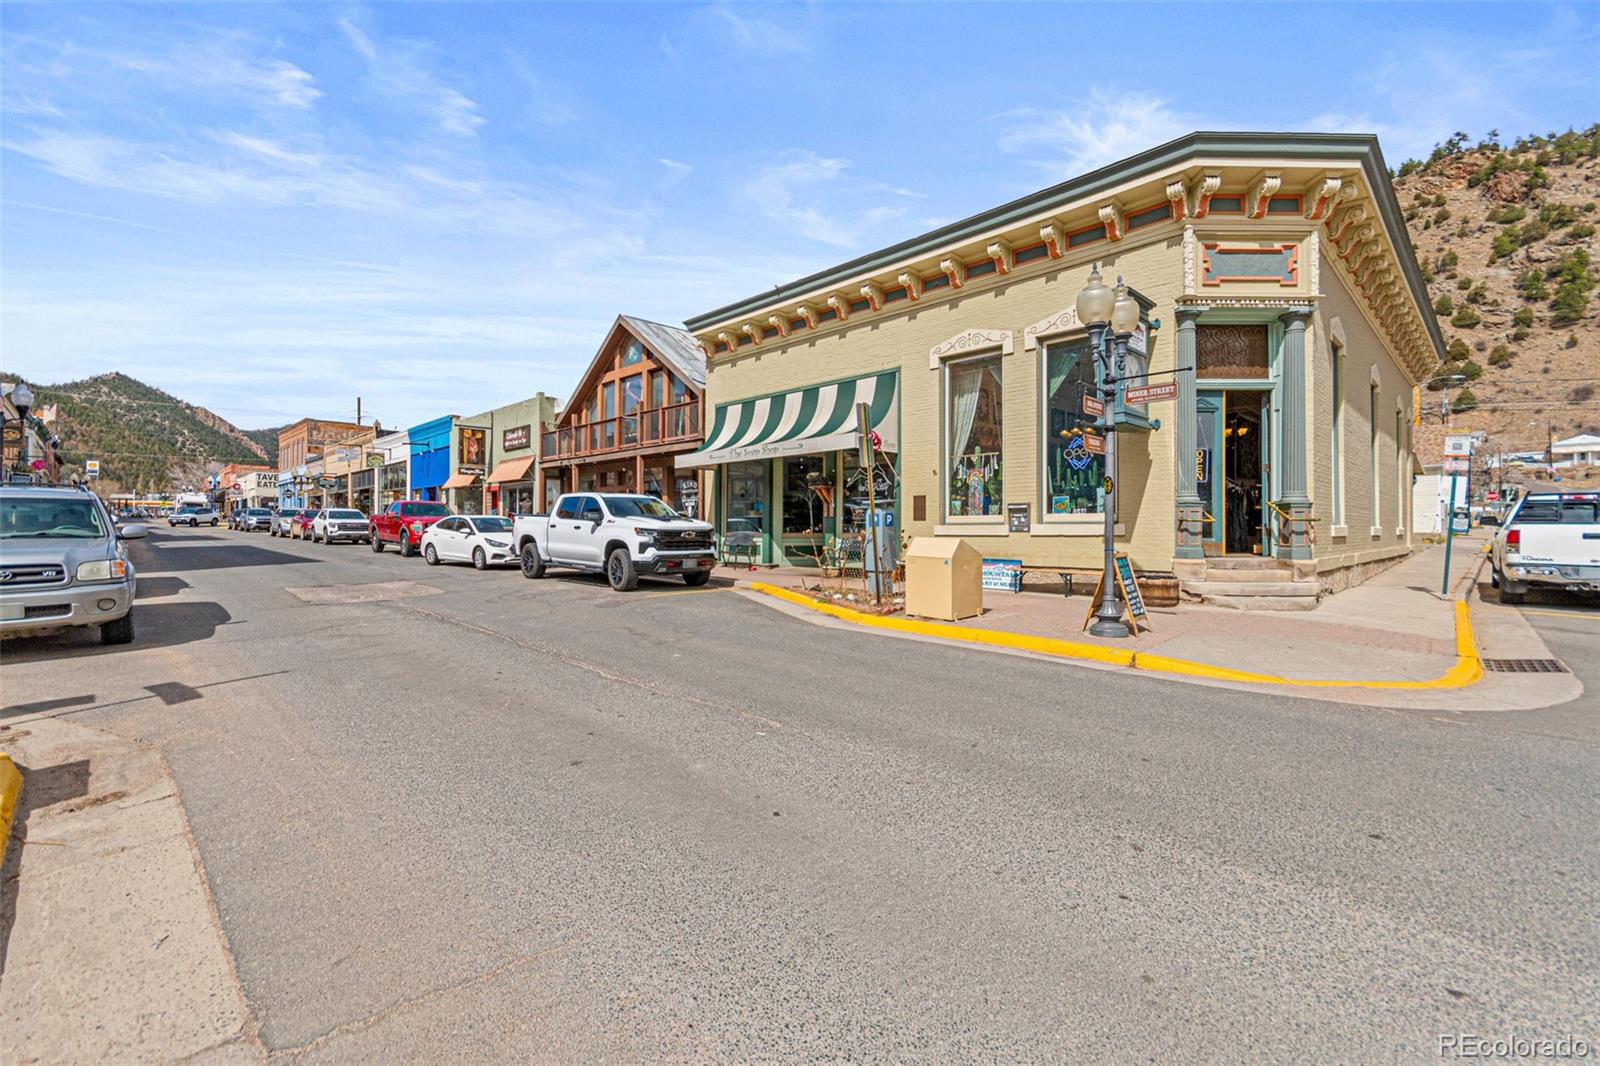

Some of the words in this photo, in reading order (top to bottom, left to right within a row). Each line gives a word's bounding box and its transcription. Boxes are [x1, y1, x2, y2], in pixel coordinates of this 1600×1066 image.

[1128, 389, 1148, 398] MINER
[1150, 386, 1175, 396] STREET
[762, 446, 779, 456] Shop
[1196, 449, 1204, 481] OPEN
[257, 473, 279, 481] TAVE
[886, 513, 893, 526] P
